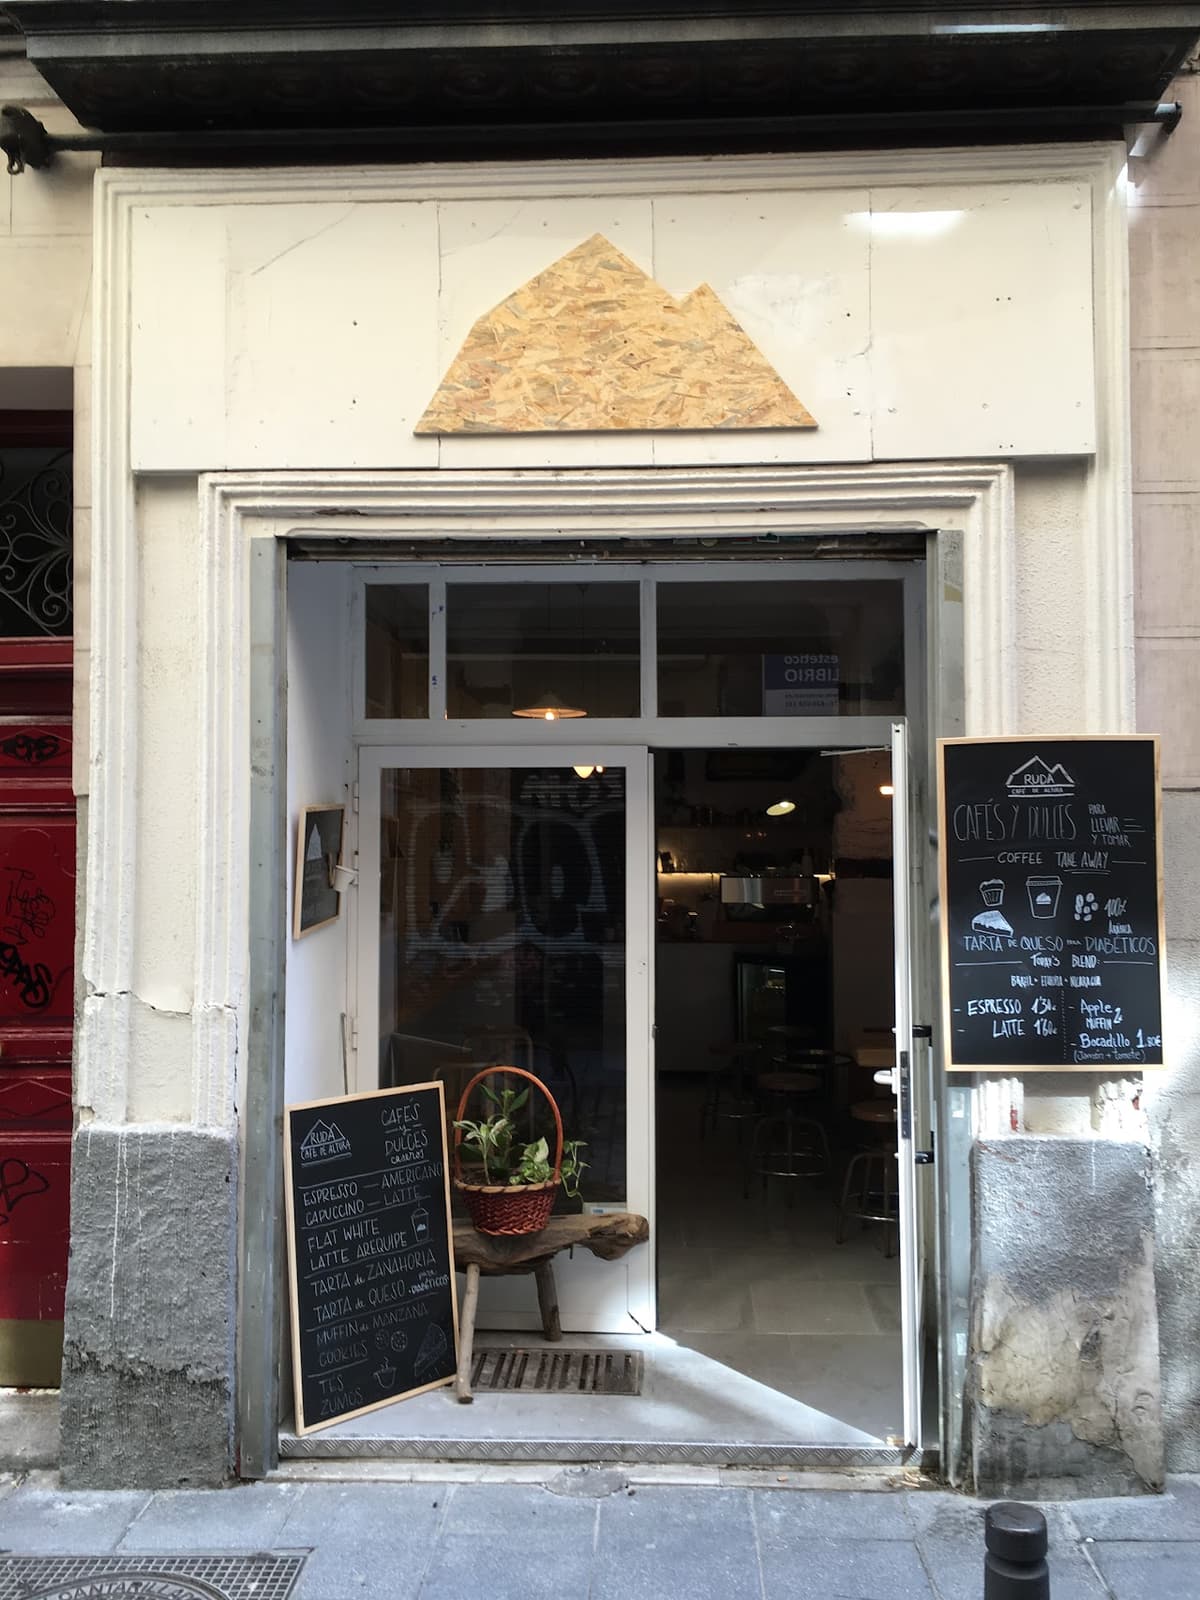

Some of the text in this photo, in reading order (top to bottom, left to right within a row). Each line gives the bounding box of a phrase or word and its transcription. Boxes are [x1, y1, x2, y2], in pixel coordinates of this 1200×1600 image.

[1024, 774, 1055, 785] RUDA
[954, 798, 1005, 841] CAFÉS
[1011, 805, 1019, 839] Y
[1091, 816, 1120, 833] LLEVAR
[997, 851, 1109, 869] COFFEE TAKE AWAY
[963, 935, 1003, 952] TARTA
[1008, 939, 1018, 948] DE
[1020, 936, 1064, 952] QUESO
[968, 998, 1021, 1016] ESPRESSO
[1081, 999, 1113, 1017] Apple
[993, 1018, 1026, 1038] LATTE
[1086, 1017, 1112, 1030] MUFFIN
[1079, 1033, 1130, 1048] Bocadillo
[310, 1131, 335, 1145] RUDA
[329, 1139, 351, 1154] ALTURA
[385, 1129, 428, 1156] DULCES
[303, 1162, 443, 1207] ESPRESSO AMERICANO
[305, 1185, 421, 1226] CAPUCCINO LATTE
[307, 1218, 380, 1253] FLAT WHITE
[310, 1231, 407, 1271] LATTE AREQUIPE
[310, 1249, 436, 1297] TARTA de ZANAHORIA
[313, 1297, 352, 1323] TARTA
[355, 1298, 366, 1310] de
[368, 1280, 405, 1305] QUESO
[316, 1320, 359, 1347] MUFFIN
[372, 1302, 430, 1329] MANZANA
[319, 1340, 368, 1368] COOKIES
[320, 1387, 364, 1416] ZUMOS
